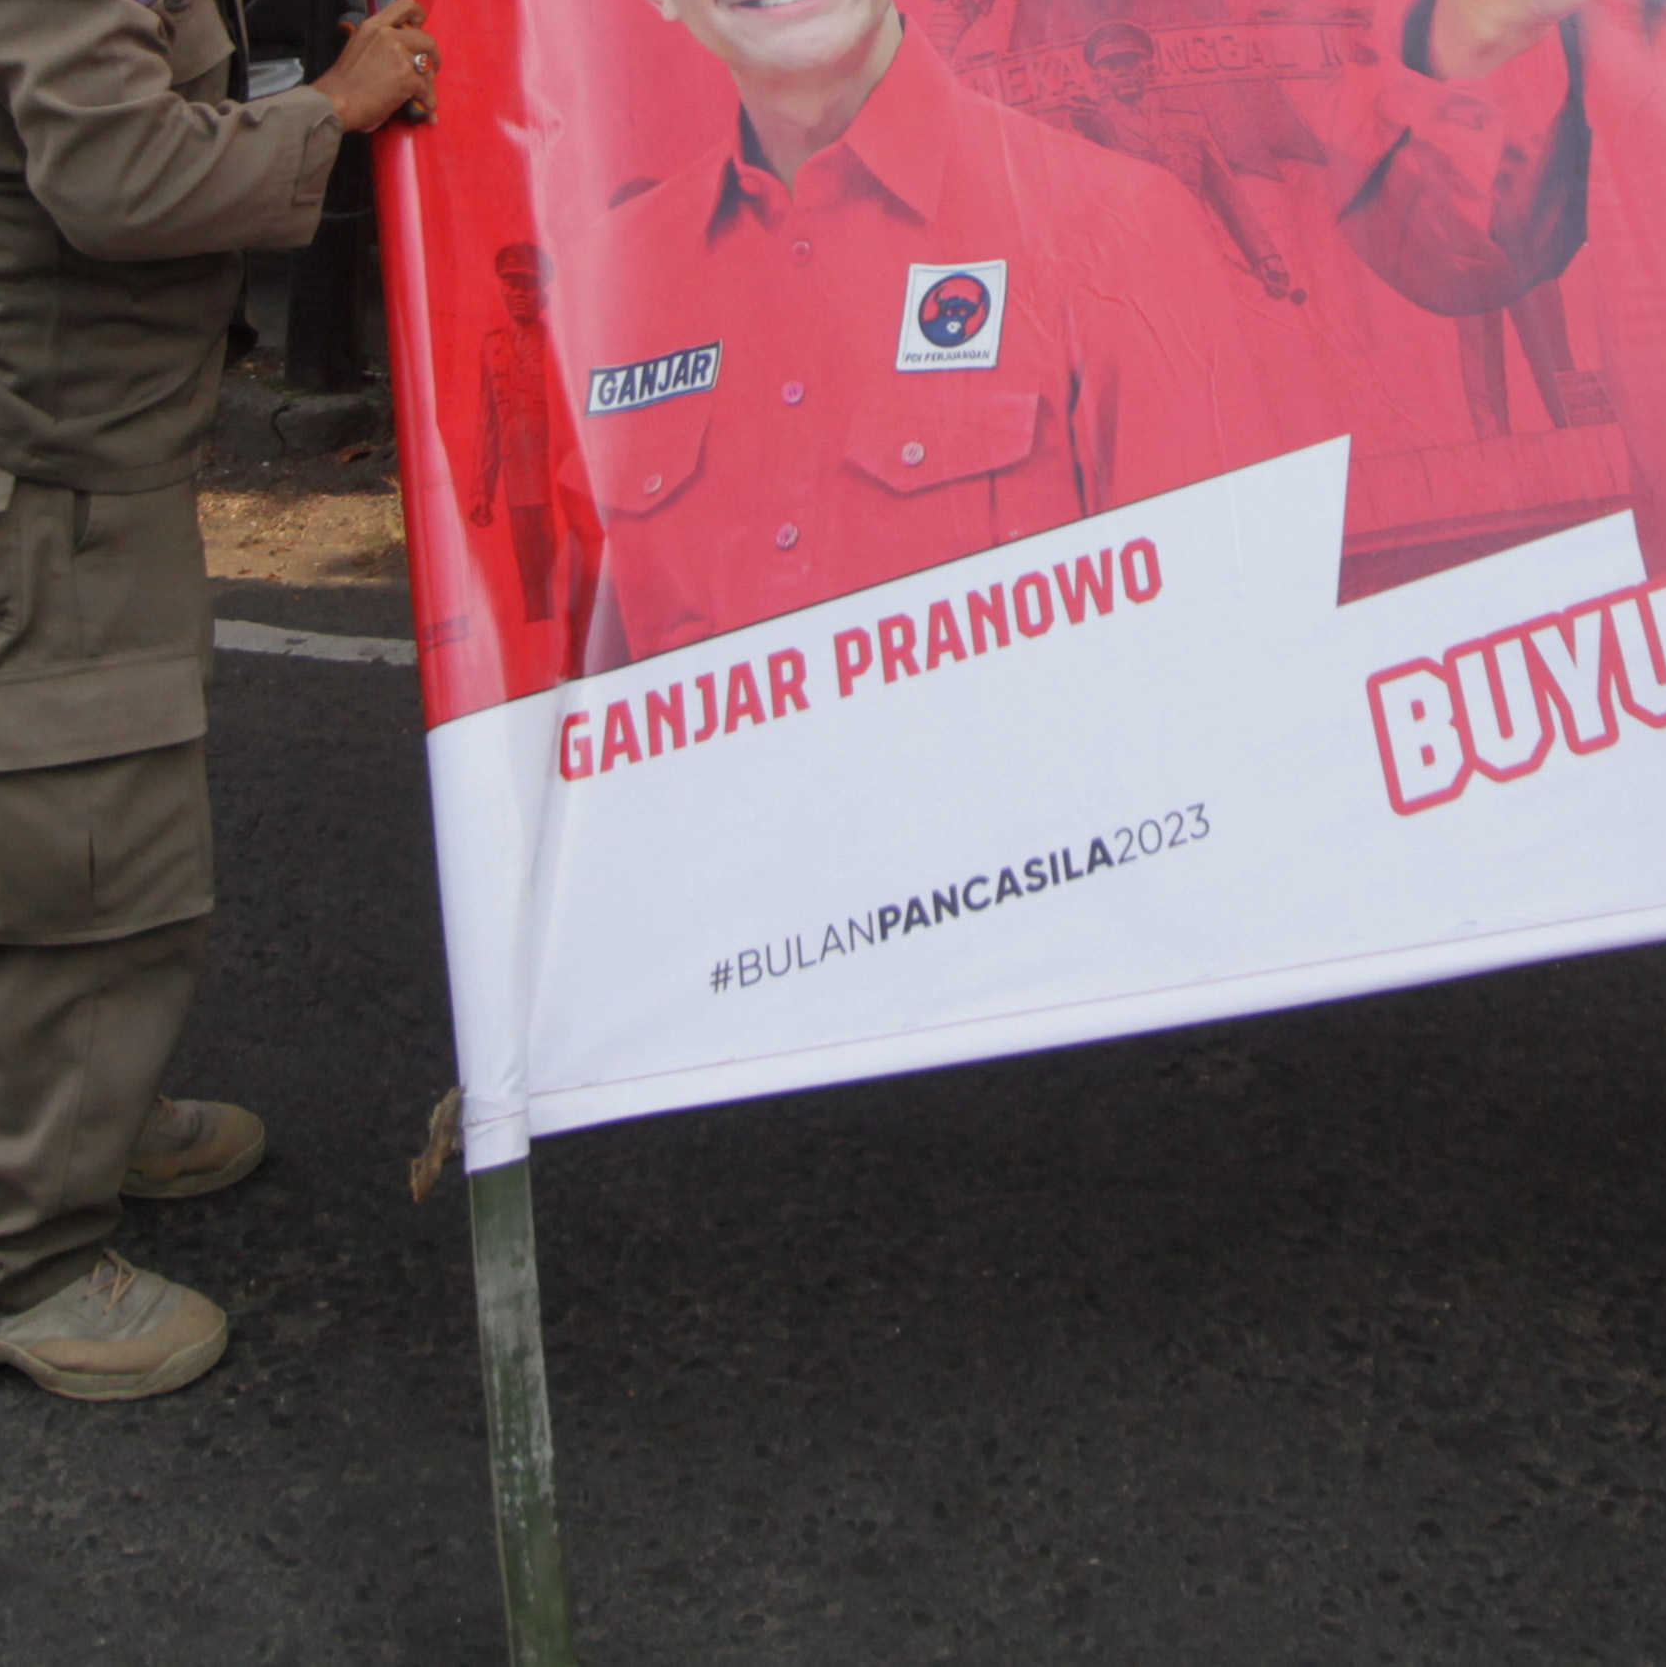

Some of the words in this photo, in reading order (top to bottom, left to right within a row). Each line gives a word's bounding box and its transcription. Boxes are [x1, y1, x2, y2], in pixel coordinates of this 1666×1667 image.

[598, 352, 712, 406] GANJAR
[558, 646, 810, 782] GANJAR
[834, 536, 1162, 699] PRANOWO
[709, 803, 1212, 994] #BULANPANCASILA2023
